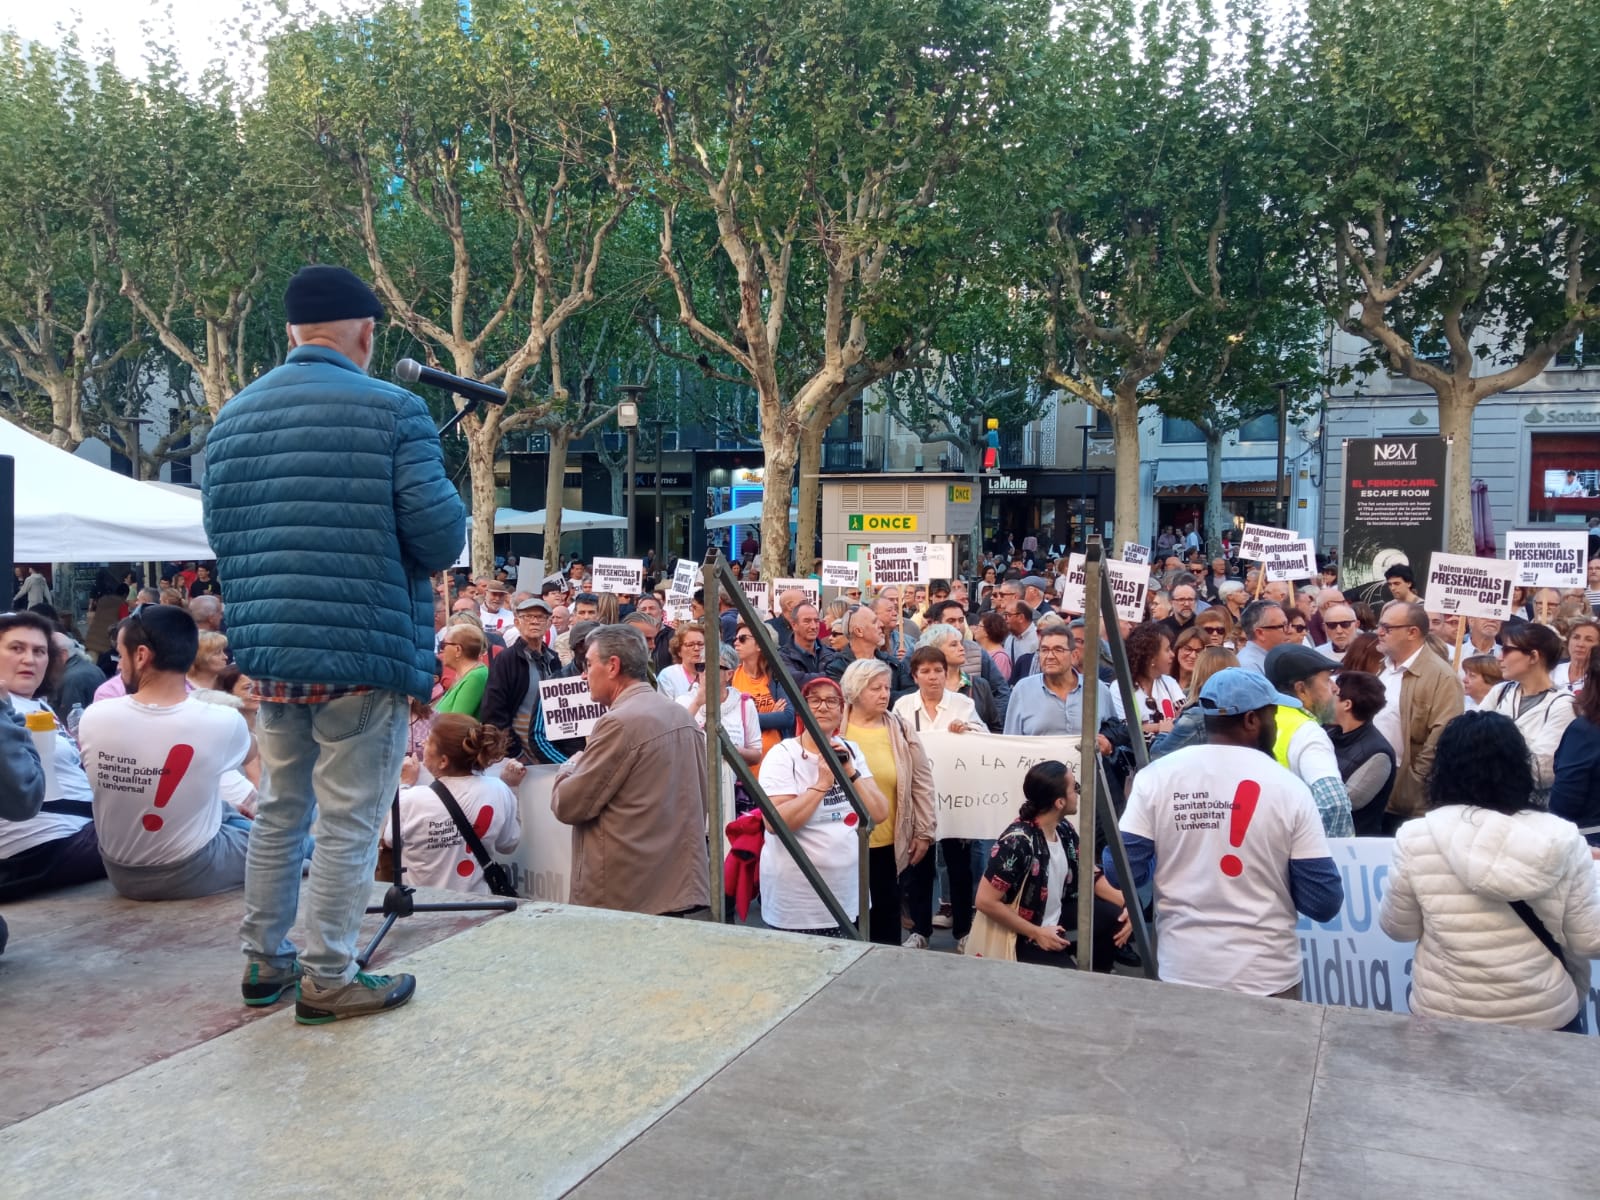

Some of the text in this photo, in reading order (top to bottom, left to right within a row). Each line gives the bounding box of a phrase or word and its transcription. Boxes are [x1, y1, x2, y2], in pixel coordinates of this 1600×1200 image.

[1352, 480, 1364, 488] EL
[955, 489, 969, 501] ONCE
[869, 517, 911, 529] ONCE
[1245, 527, 1290, 541] potenciem
[874, 547, 908, 555] defensem
[1242, 541, 1264, 553] PRIM
[1265, 543, 1307, 554] potenciem
[1509, 549, 1575, 561] PRESENCIALS
[874, 559, 912, 571] SANITAT
[1438, 564, 1488, 577] Volem visites
[594, 568, 635, 577] PRESENCIALS
[1431, 572, 1502, 591] PRESENCIALS
[1453, 588, 1479, 597] nostre
[558, 697, 569, 708] la
[98, 751, 115, 762] Per
[117, 757, 137, 765] una
[955, 758, 967, 770] A
[982, 754, 1006, 769] LA
[98, 763, 171, 776] sanitat pública
[97, 771, 152, 785] de qualitat
[102, 782, 145, 794] universal
[1173, 792, 1189, 800] Per
[1192, 791, 1209, 799] una
[1173, 800, 1241, 811] sanitat pública
[1174, 812, 1187, 821] de
